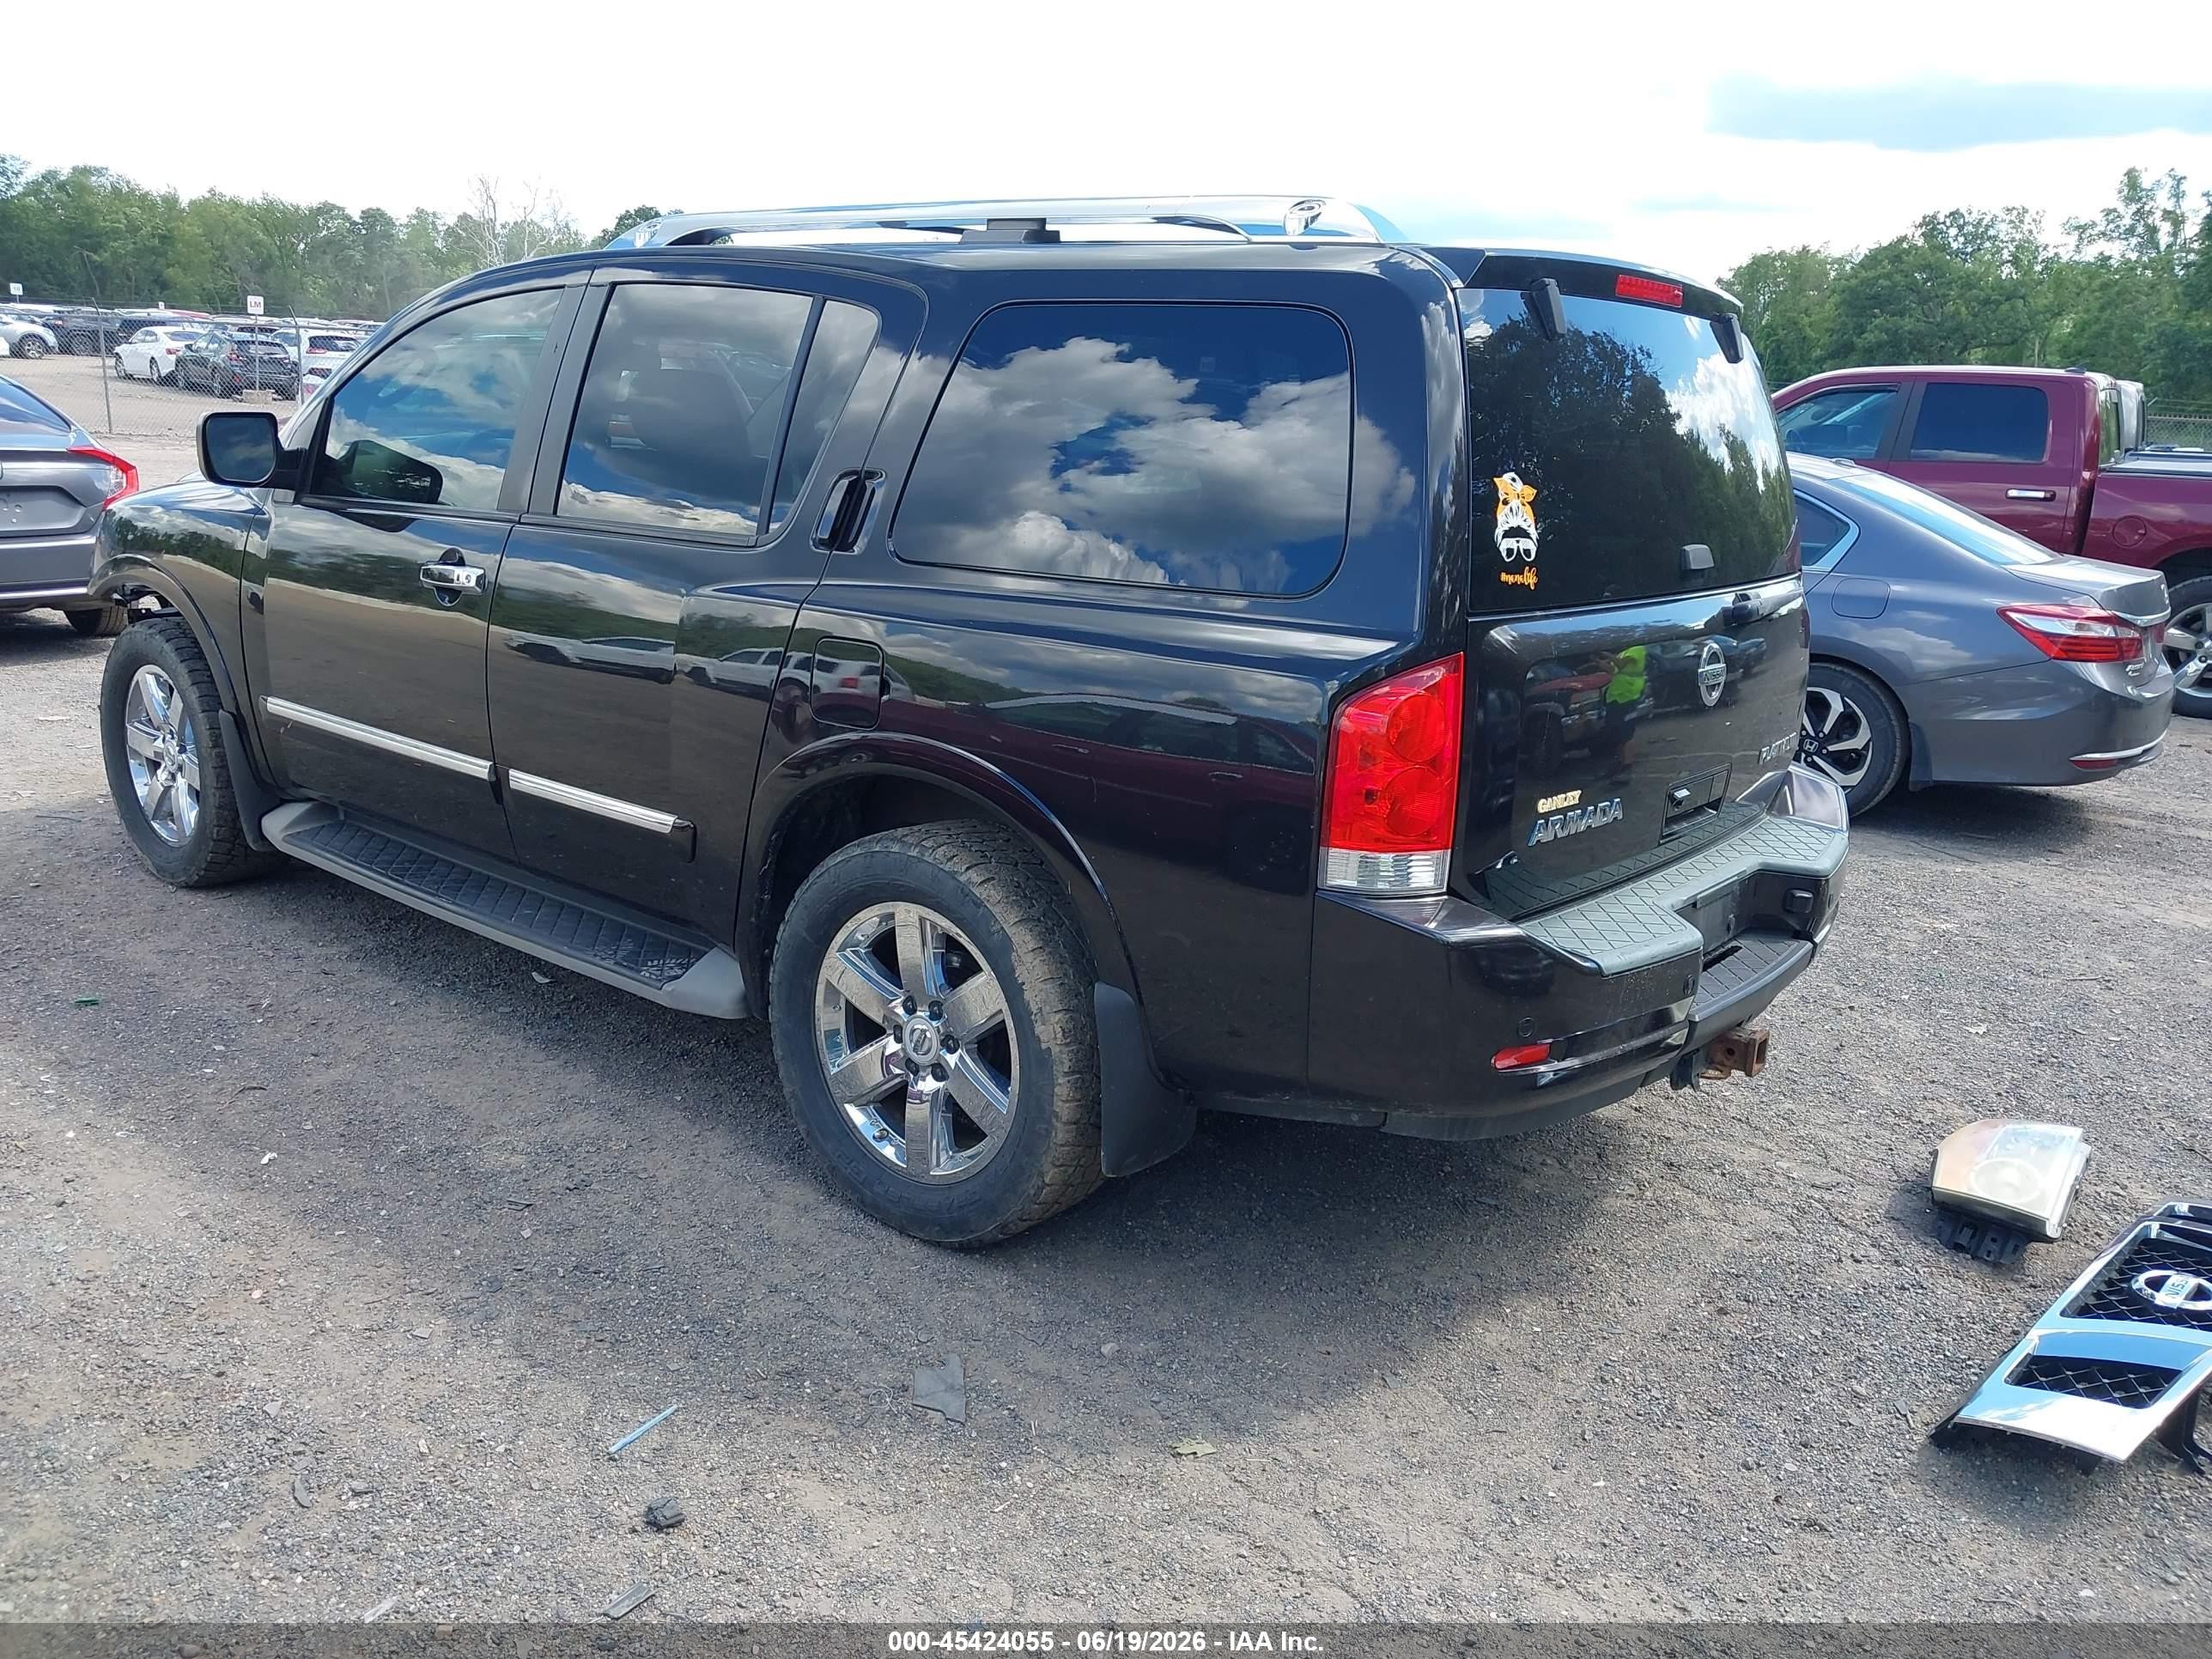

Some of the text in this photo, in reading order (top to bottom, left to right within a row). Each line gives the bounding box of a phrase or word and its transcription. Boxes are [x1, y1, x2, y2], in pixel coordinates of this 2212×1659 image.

[1500, 566, 1538, 590] #nanalife
[1704, 667, 1725, 682] NISSA
[1528, 798, 1623, 847] ARMADA
[2165, 1274, 2191, 1298] NISS
